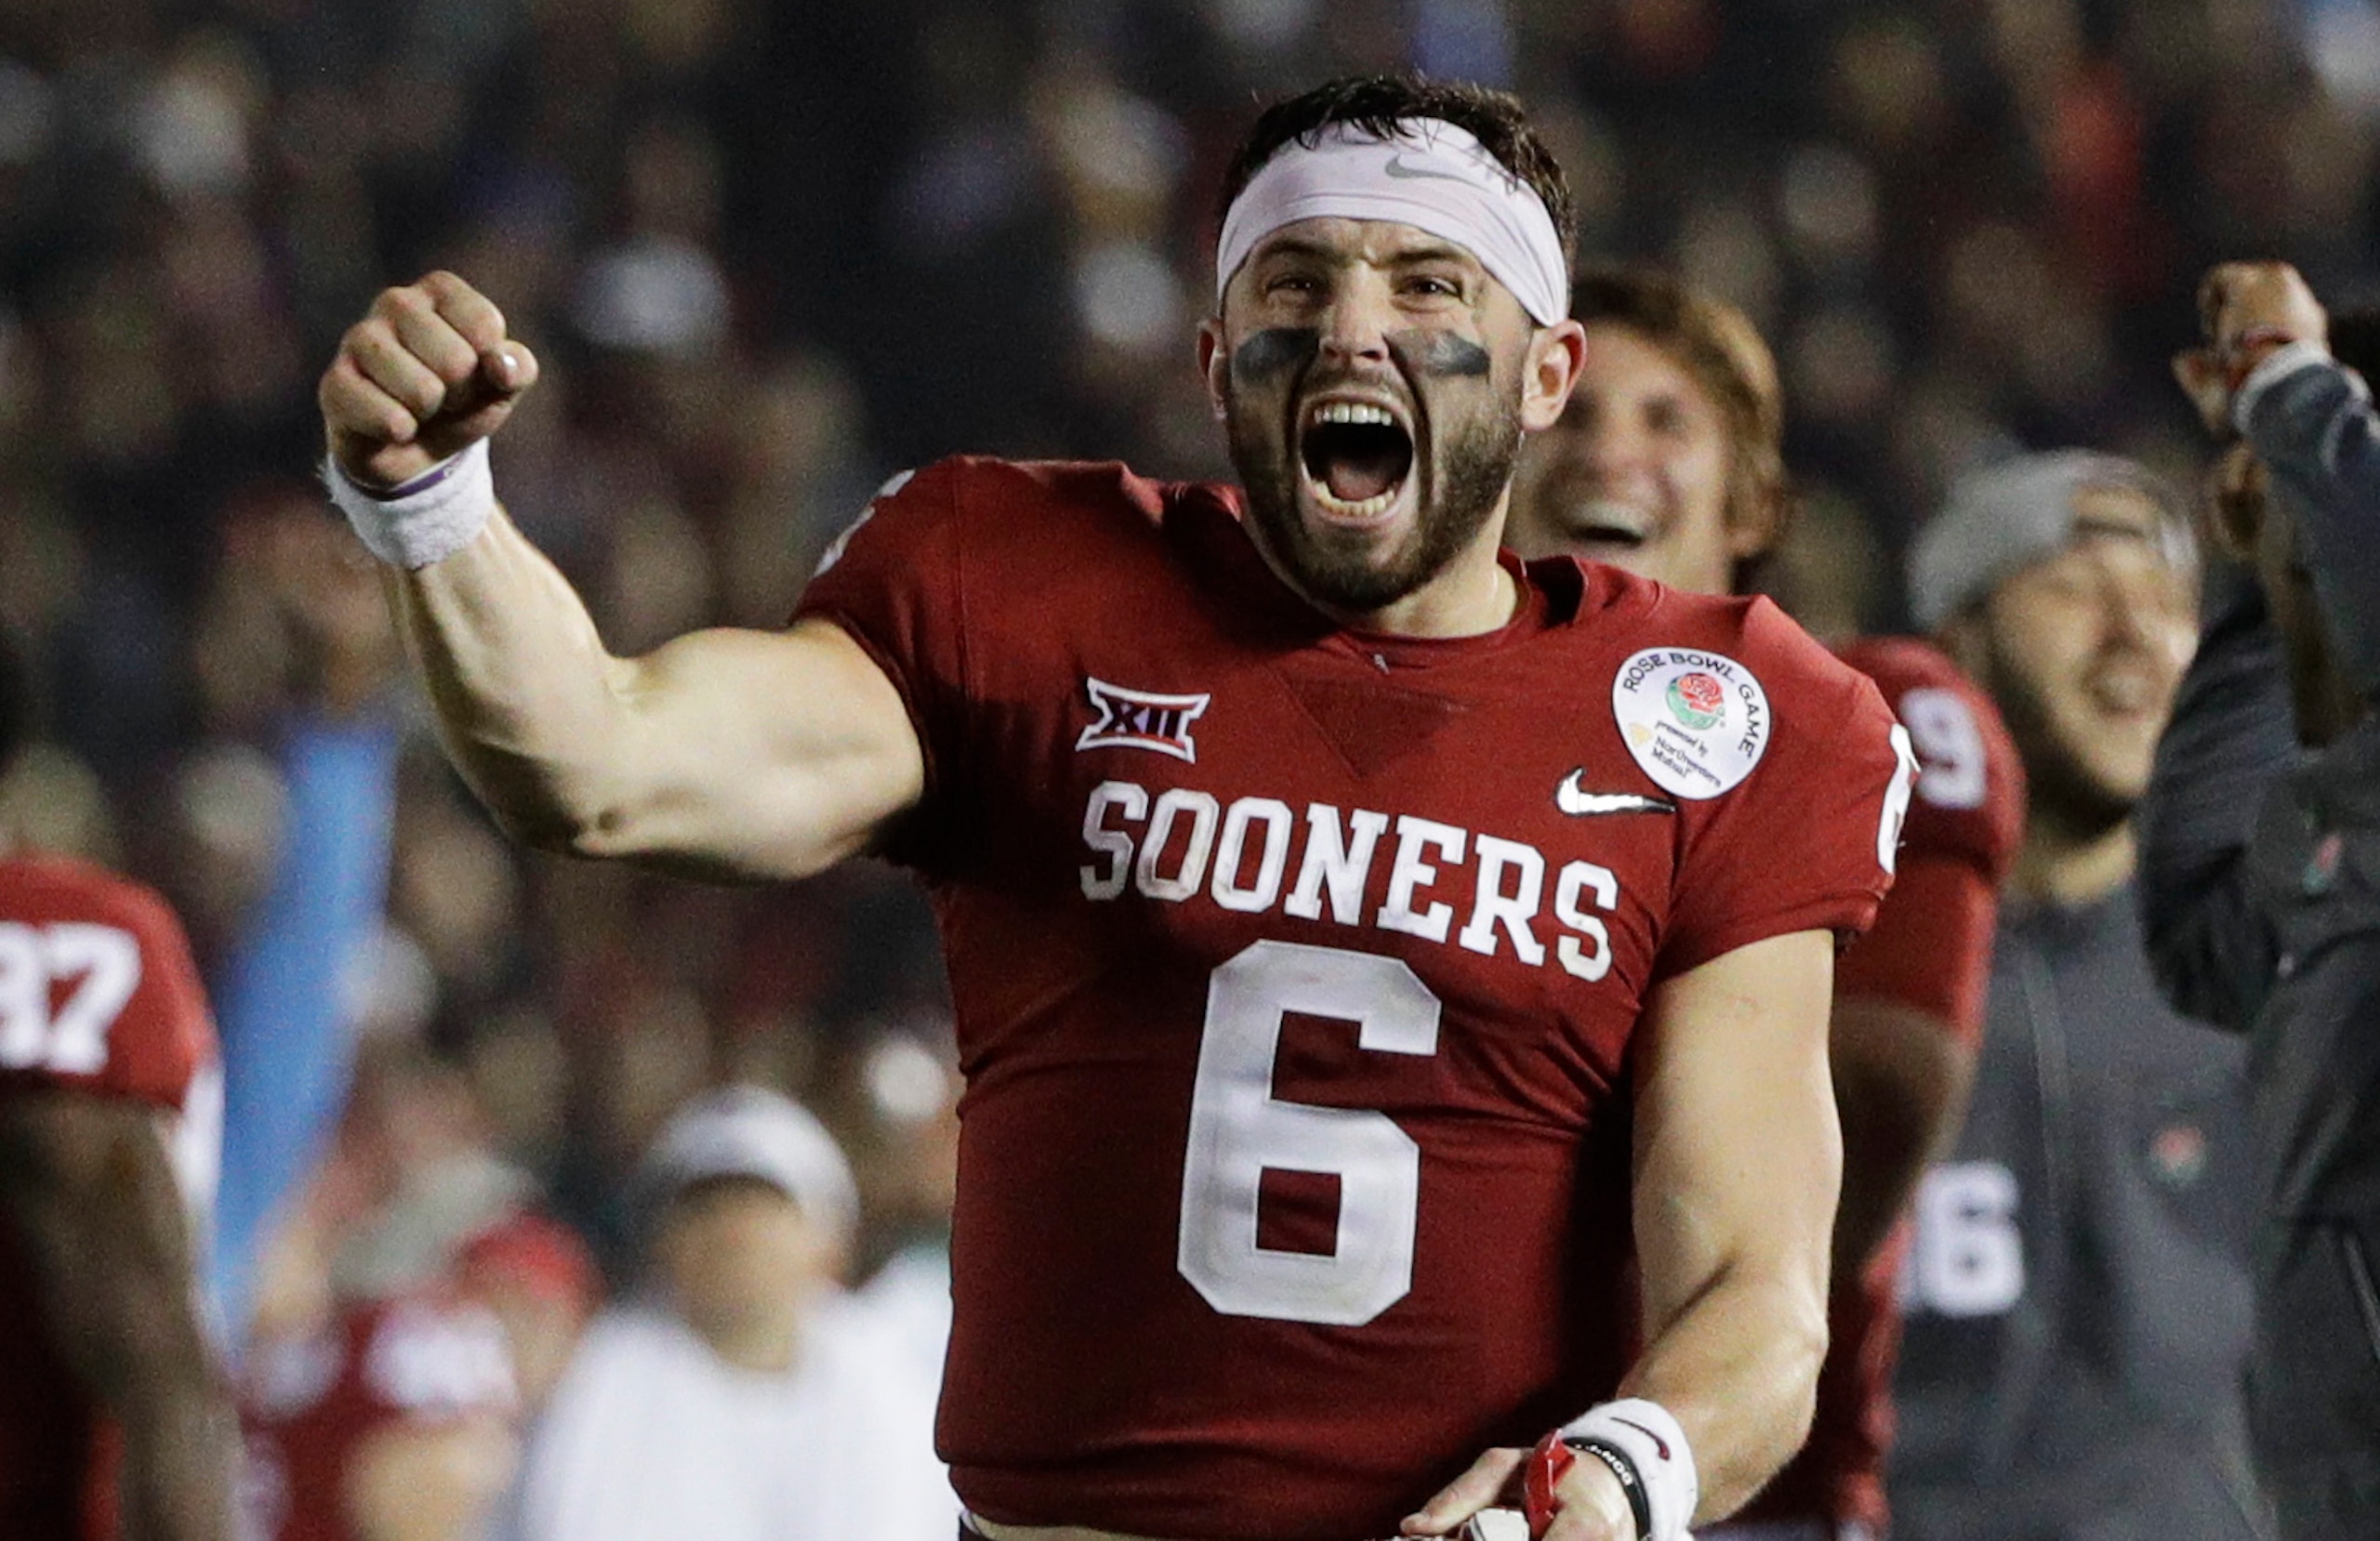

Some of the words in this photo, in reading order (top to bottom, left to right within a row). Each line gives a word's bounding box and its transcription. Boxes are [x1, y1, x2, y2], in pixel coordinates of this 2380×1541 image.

[1623, 653, 1667, 693] ROSE
[1669, 652, 1736, 684] BOWL
[1738, 683, 1761, 758] GAME
[1079, 780, 1619, 982] SOONERS
[1177, 938, 1443, 1327] 6
